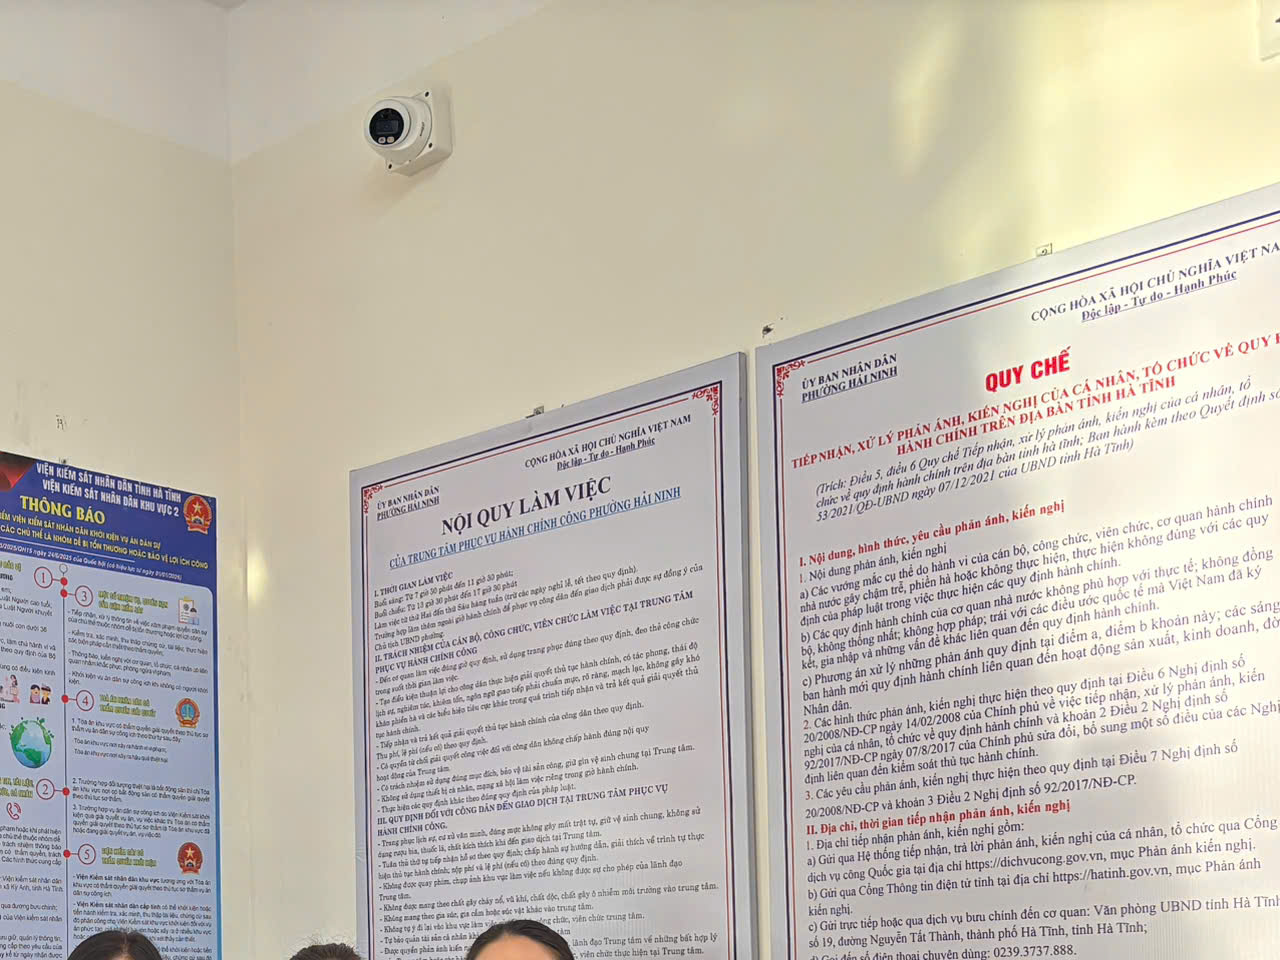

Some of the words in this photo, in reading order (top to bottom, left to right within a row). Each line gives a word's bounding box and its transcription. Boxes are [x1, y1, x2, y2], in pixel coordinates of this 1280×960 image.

[1031, 303, 1066, 321] CỘNG
[1069, 295, 1097, 311] HÒA
[1099, 286, 1117, 303] XÃ
[1120, 280, 1143, 297] HỘI
[1147, 269, 1175, 288] CHỦ
[1178, 257, 1221, 279] NGHĨA
[1225, 247, 1258, 266] VIỆT
[1261, 241, 1280, 256] NA
[1081, 308, 1101, 323] Độc
[1104, 303, 1121, 317] lập
[1133, 295, 1147, 307] Tự
[1149, 291, 1164, 303] do
[1174, 278, 1205, 295] Hạnh
[1208, 270, 1237, 286] Phúc
[801, 380, 846, 404] PHƯỜNG
[848, 373, 868, 390] HẢI
[870, 365, 898, 383] NINH
[802, 377, 816, 389] ỦY
[818, 370, 839, 385] BAN
[841, 360, 872, 378] NHÂN
[874, 353, 897, 368] DÂN
[985, 364, 1024, 392] QUY
[1030, 346, 1070, 379] CHẾ
[790, 453, 818, 469] TIẾP
[816, 443, 856, 462] NHẬN,
[856, 435, 876, 452] XỬ
[877, 430, 894, 446] LÝ
[896, 422, 931, 441] PHẢN
[932, 414, 966, 431] ÁNH,
[966, 405, 1000, 423] KIẾN
[1002, 395, 1039, 419] NGHỊ
[1039, 386, 1069, 404] CỦA
[1071, 378, 1092, 395] CÁ
[1094, 369, 1139, 390] NHÂN,
[1165, 350, 1211, 372] CHỨC
[1234, 335, 1271, 354] QUY
[897, 437, 932, 455] HÀNH
[935, 425, 978, 445] CHÍNH
[980, 415, 1015, 434] TRÊN
[1019, 410, 1043, 425] ĐỊA
[1046, 401, 1073, 418] BÀN
[1079, 391, 1112, 409] TỈNH
[1116, 383, 1137, 400] HÀ
[1142, 375, 1176, 393] TĨNH
[19, 494, 72, 518] THÔNG
[76, 505, 106, 525] BÁO
[388, 553, 408, 571] CỦA
[407, 548, 438, 566] TRUNG
[437, 542, 459, 558] TÂM
[457, 535, 484, 553] PHỤC
[483, 532, 498, 547] VỤ
[498, 525, 526, 543] HÀNH
[526, 516, 558, 535] CHÍNH
[558, 509, 588, 529] CÔNG
[588, 498, 632, 520] PHƯỜNG
[632, 493, 653, 509] HẢI
[654, 486, 682, 504] NINH
[442, 512, 472, 535] NỘI
[477, 501, 515, 528] QUY
[519, 489, 560, 515] LÀM
[564, 476, 611, 501] VIỆC
[809, 552, 826, 565] Nội
[827, 548, 856, 561] dung,
[858, 540, 881, 554] hình
[883, 535, 910, 548] thức,
[911, 529, 930, 545] yêu
[932, 523, 952, 538] cầu
[954, 519, 982, 536] phản
[984, 512, 1010, 526] ánh,
[1012, 503, 1036, 521] kiến
[1039, 499, 1065, 515] nghị
[806, 824, 818, 835] II.
[820, 823, 837, 835] Địa
[839, 820, 858, 832] chỉ,
[859, 818, 880, 830] thời
[881, 816, 904, 830] gian
[906, 810, 927, 827] tiếp
[929, 810, 956, 824] nhận
[959, 807, 986, 822] phản
[989, 804, 1014, 817] ánh,
[1017, 799, 1041, 814] kiến
[1045, 798, 1070, 814] nghị
[961, 948, 990, 960] dùng:
[993, 943, 1077, 958] 0239.3737.888.
